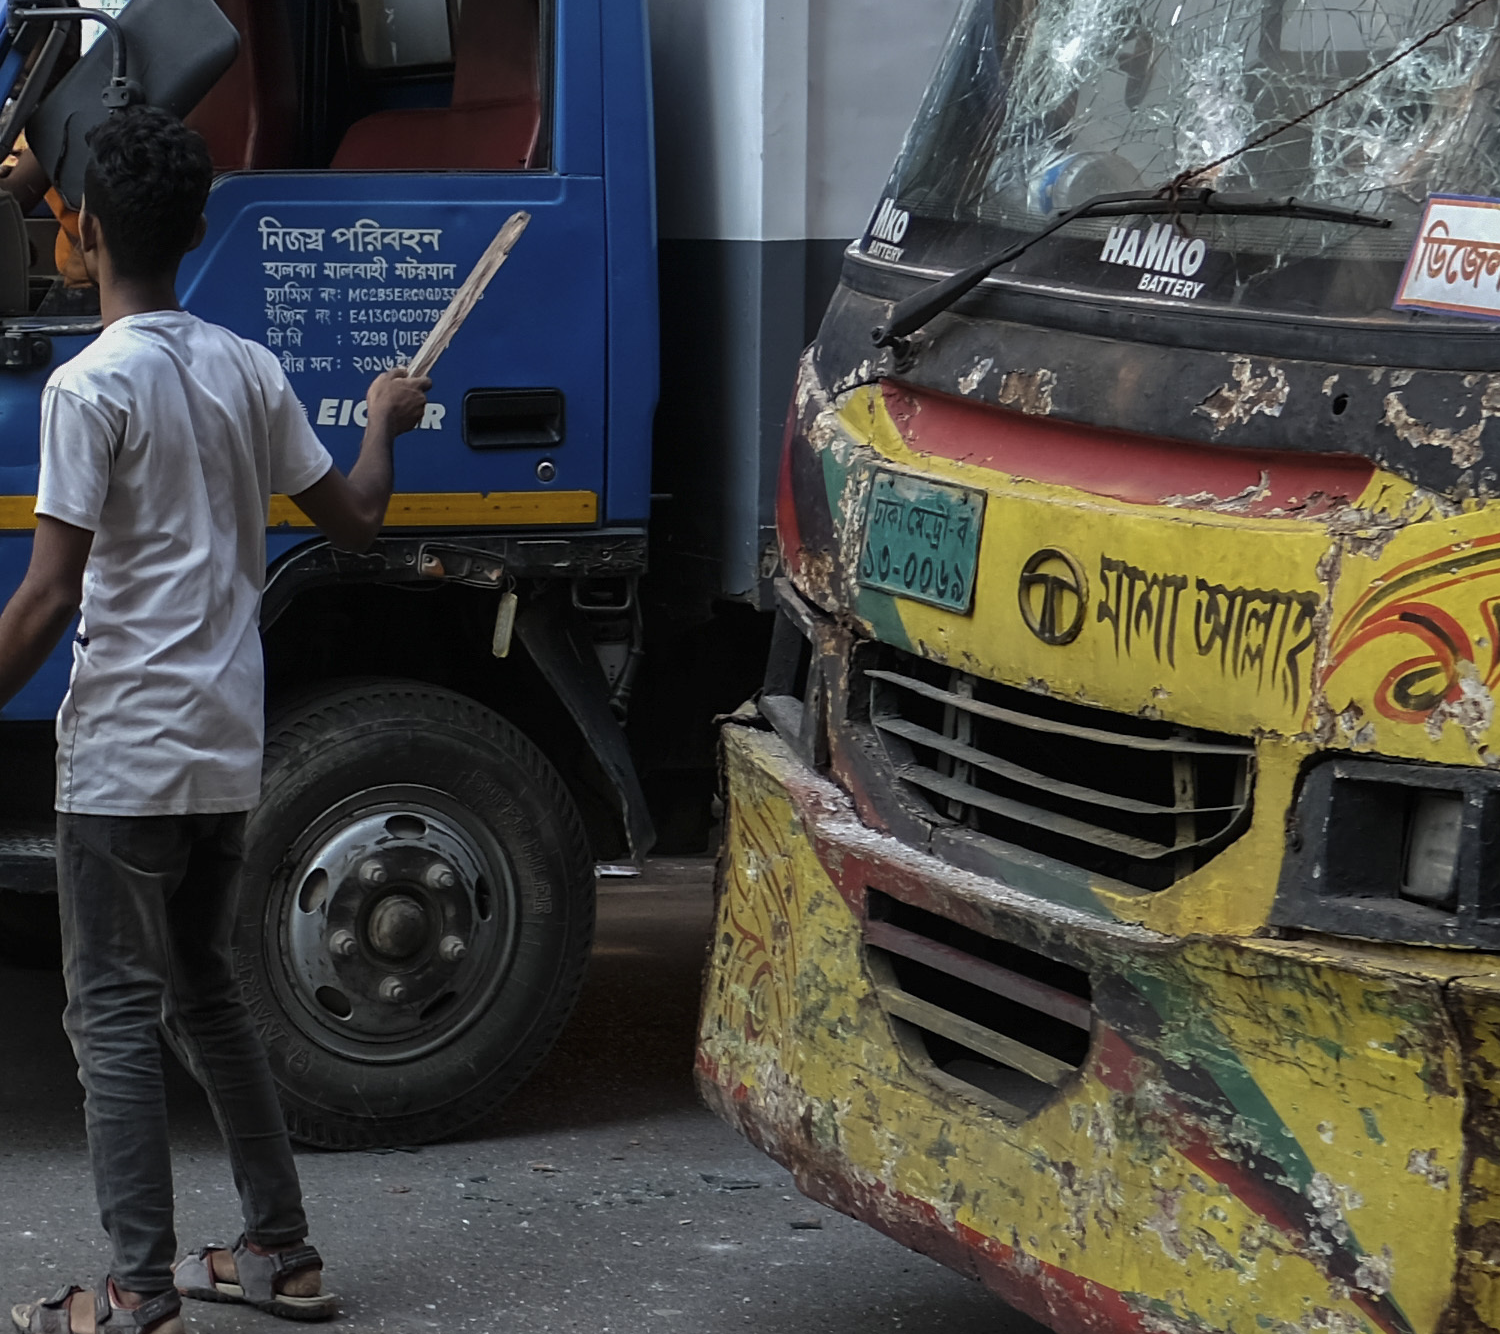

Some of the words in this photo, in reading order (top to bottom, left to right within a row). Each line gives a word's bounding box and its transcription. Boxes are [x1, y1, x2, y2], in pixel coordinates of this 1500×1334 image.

[258, 216, 325, 252] নিজস্ব
[332, 219, 442, 253] পরিবহন
[870, 198, 909, 244] MKO
[1101, 223, 1206, 277] HAMKO
[263, 261, 317, 279] হালকা
[324, 256, 388, 282] মালবাহী
[1137, 273, 1205, 299] BATTERY
[351, 331, 388, 345] 3298
[317, 398, 446, 430] EICR
[874, 499, 905, 531] ঢাকা
